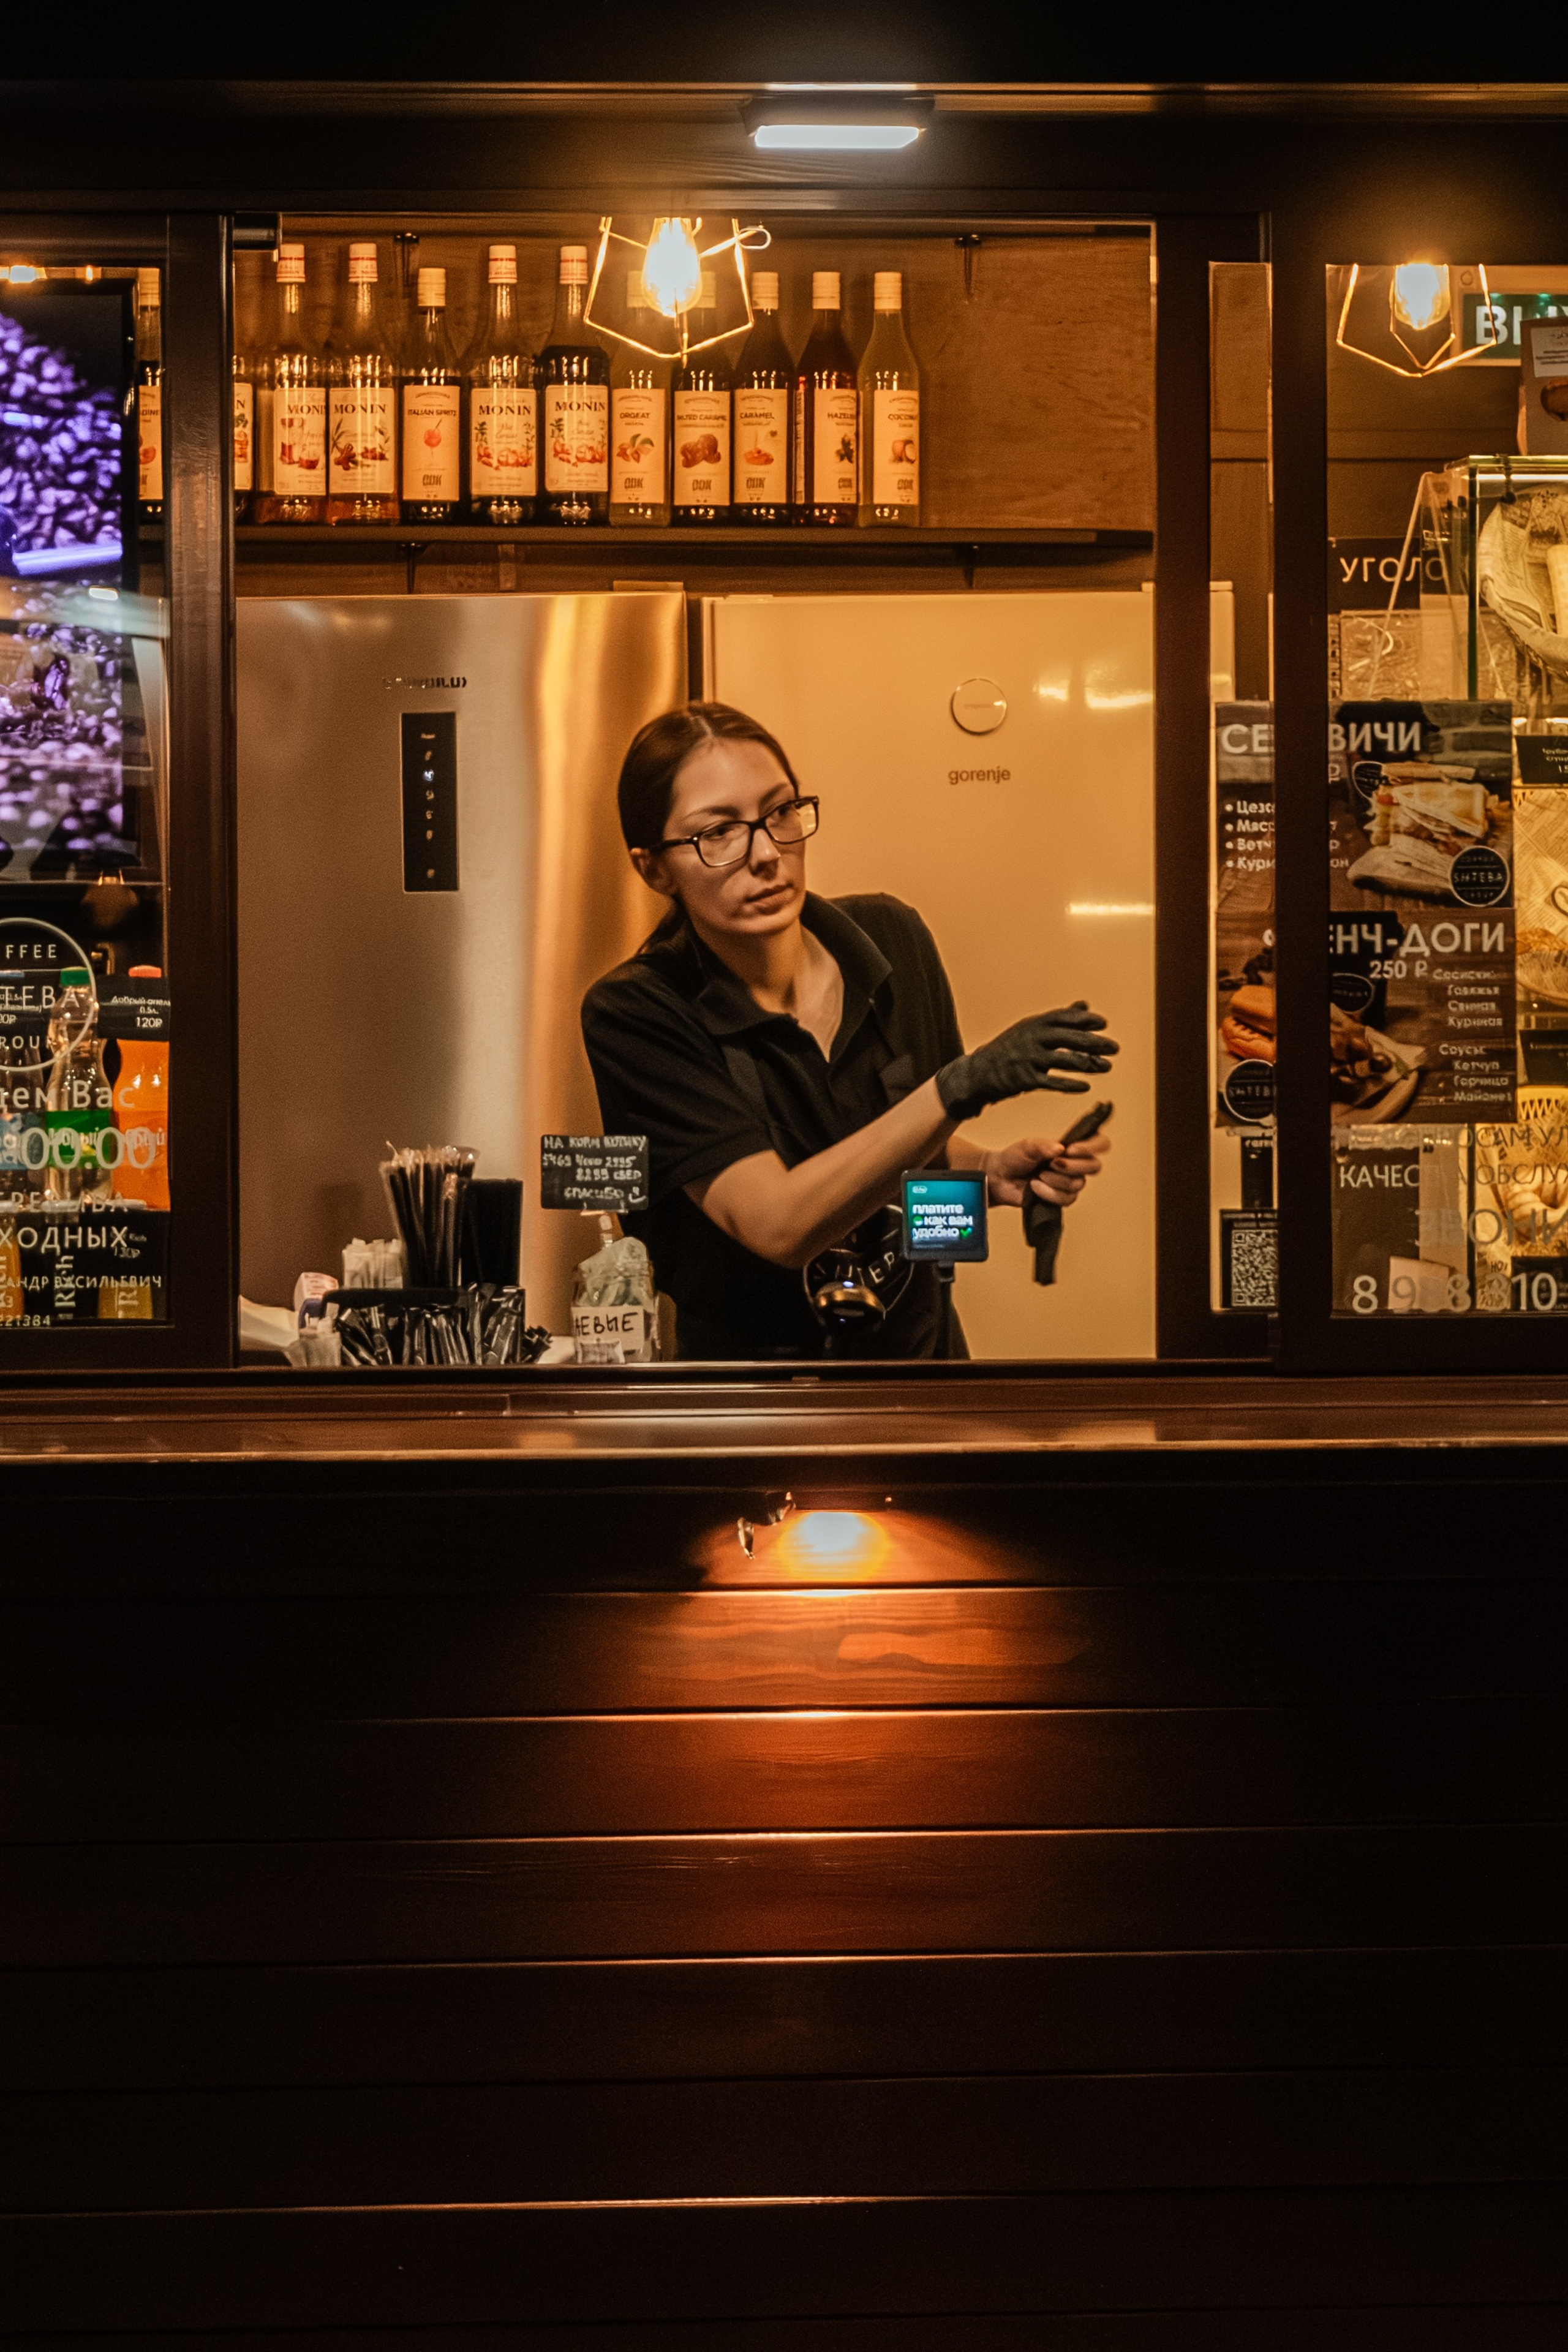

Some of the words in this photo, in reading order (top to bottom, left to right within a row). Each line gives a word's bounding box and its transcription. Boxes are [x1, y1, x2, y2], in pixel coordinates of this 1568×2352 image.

[334, 404, 386, 414] MONIN
[478, 405, 532, 415] MONIN
[554, 401, 606, 412] MONIN
[948, 766, 1011, 785] gorenje
[1369, 960, 1408, 979] 250
[1453, 1060, 1500, 1072] Кетчуп
[72, 1079, 136, 1109] Вас
[544, 1136, 564, 1149] НА
[912, 1204, 965, 1215] платите
[924, 1215, 948, 1226] как
[948, 1215, 973, 1226] вам
[912, 1224, 960, 1240] удобно
